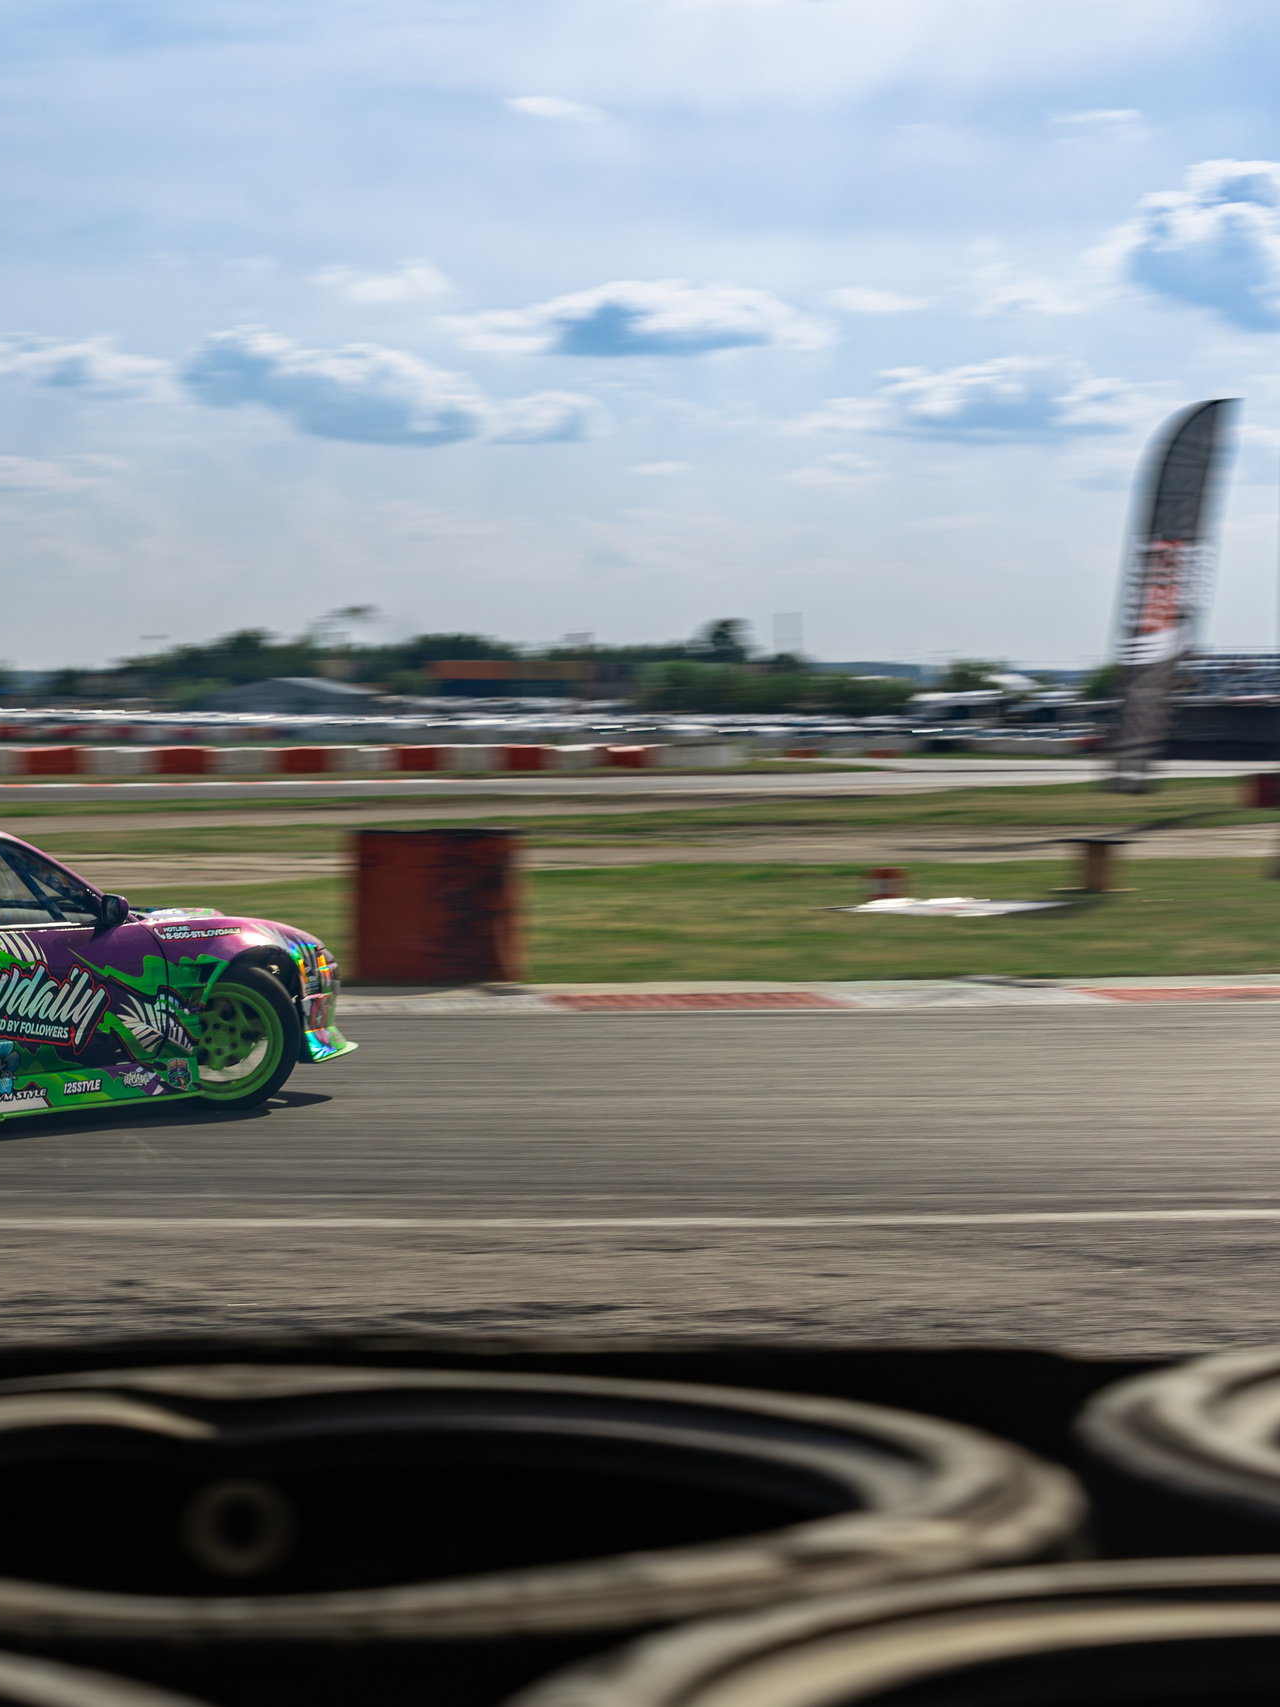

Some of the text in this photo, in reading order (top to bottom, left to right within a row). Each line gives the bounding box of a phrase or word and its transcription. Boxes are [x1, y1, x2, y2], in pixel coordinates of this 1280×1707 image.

[7, 1020, 20, 1032] BY
[20, 1021, 69, 1039] FOLLOWERS
[16, 1088, 47, 1100] STYLE
[63, 1079, 102, 1095] 125STYLE
